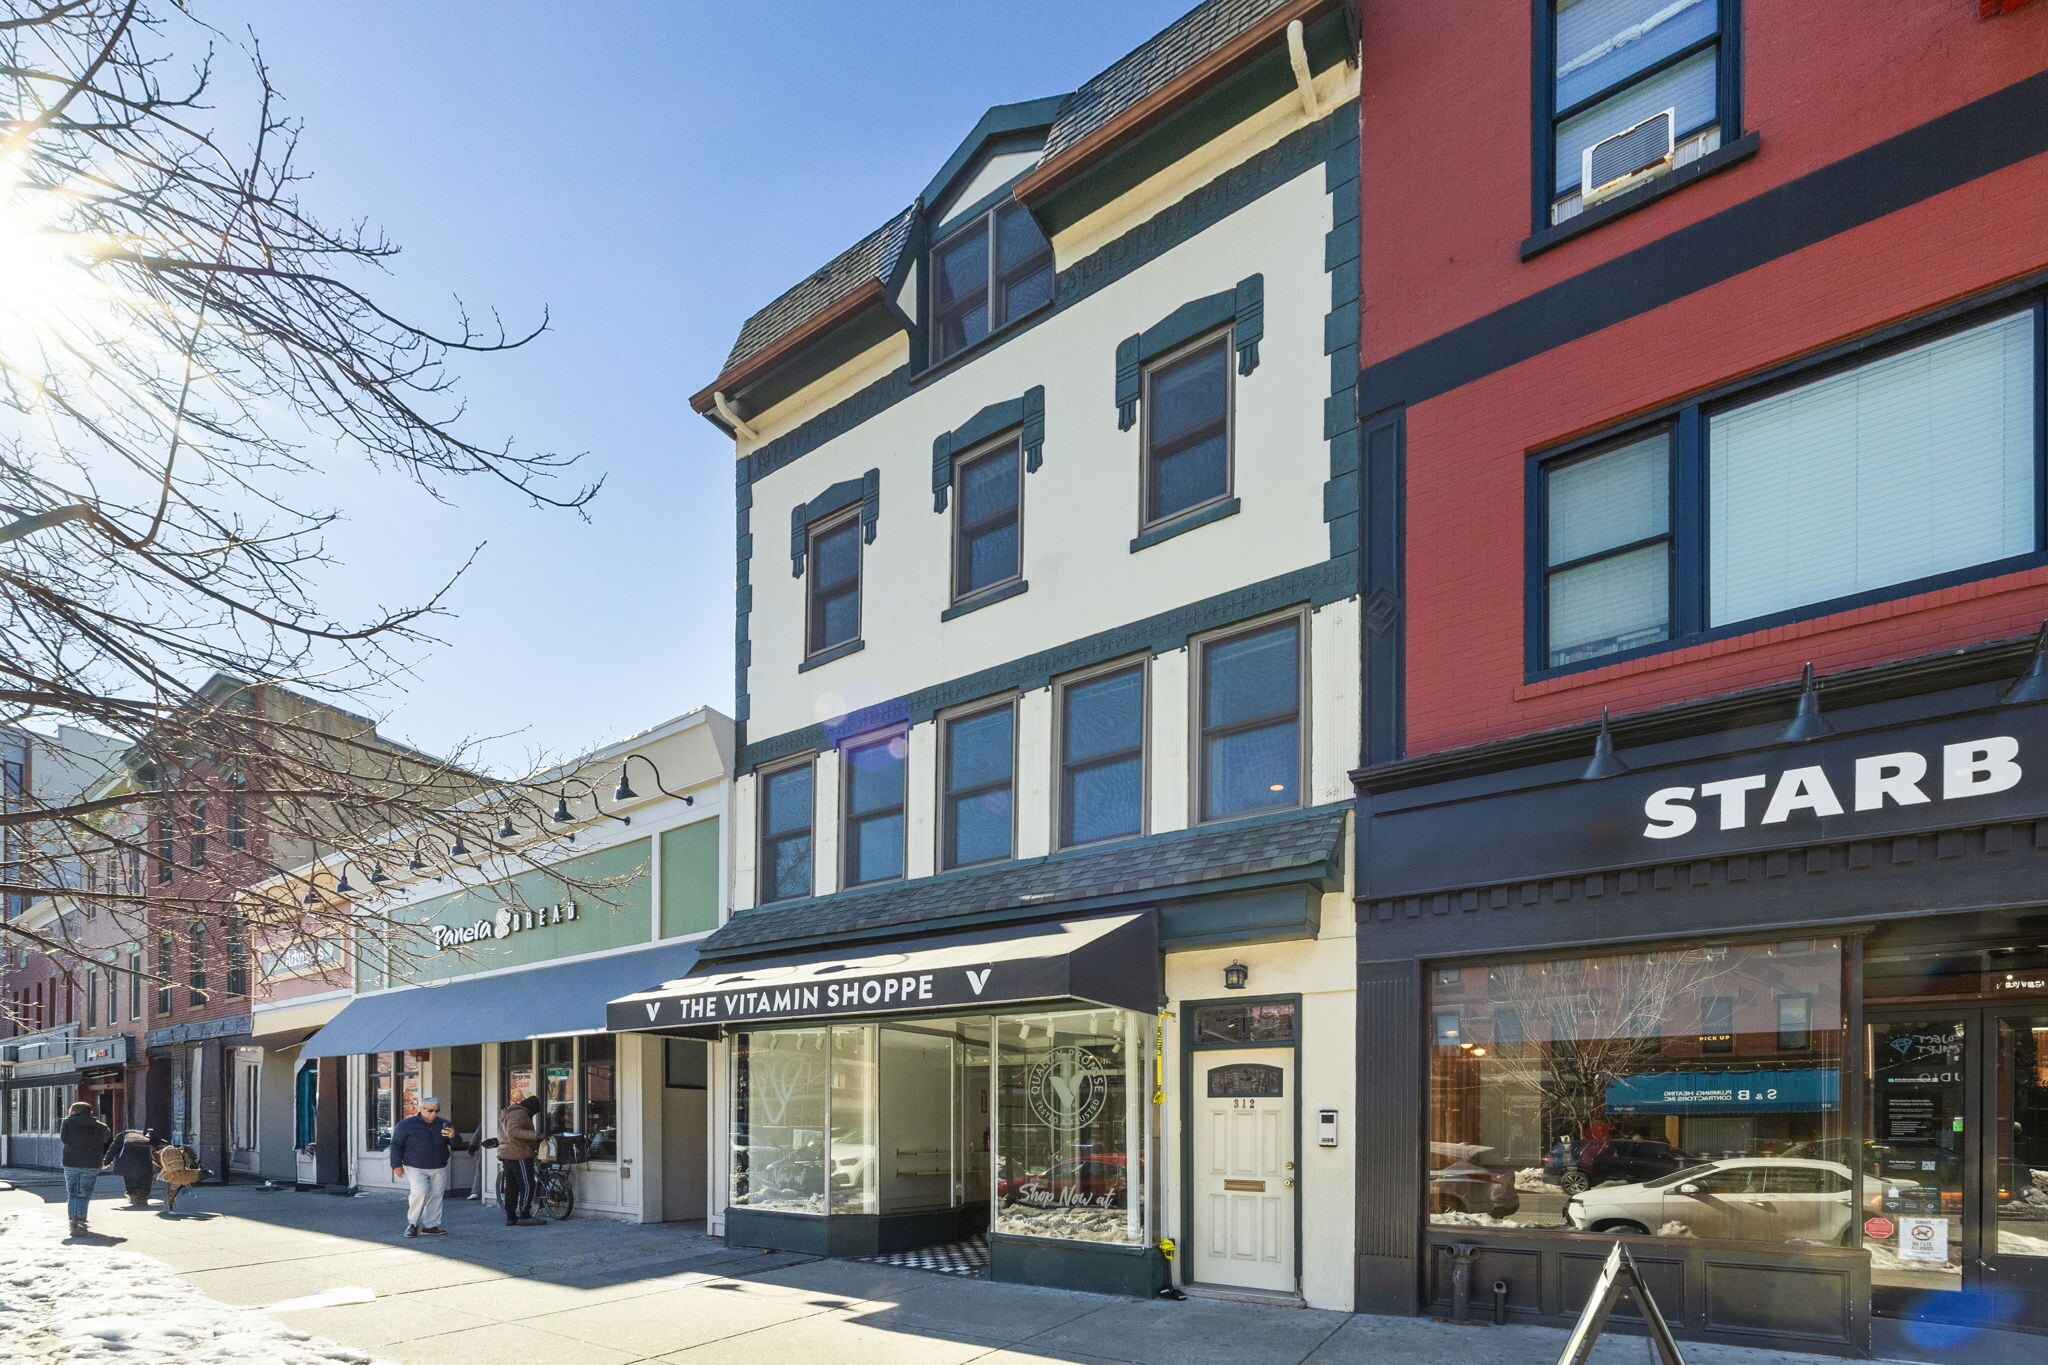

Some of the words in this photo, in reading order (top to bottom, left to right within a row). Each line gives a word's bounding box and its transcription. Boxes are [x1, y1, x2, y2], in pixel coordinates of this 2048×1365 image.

[1642, 735, 2023, 840] STARB
[432, 920, 492, 951] Panera
[680, 996, 717, 1019] THE
[724, 986, 819, 1016] VITAMIN
[827, 974, 934, 1008] SHOPPE
[1031, 1049, 1063, 1095] QUALITY
[1068, 1049, 1104, 1093] PROMISE
[1035, 1100, 1059, 1124] TESTED
[1233, 1098, 1255, 1109] 312
[1018, 1182, 1055, 1208] Shop
[1059, 1184, 1093, 1207] Now
[1096, 1187, 1116, 1209] at
